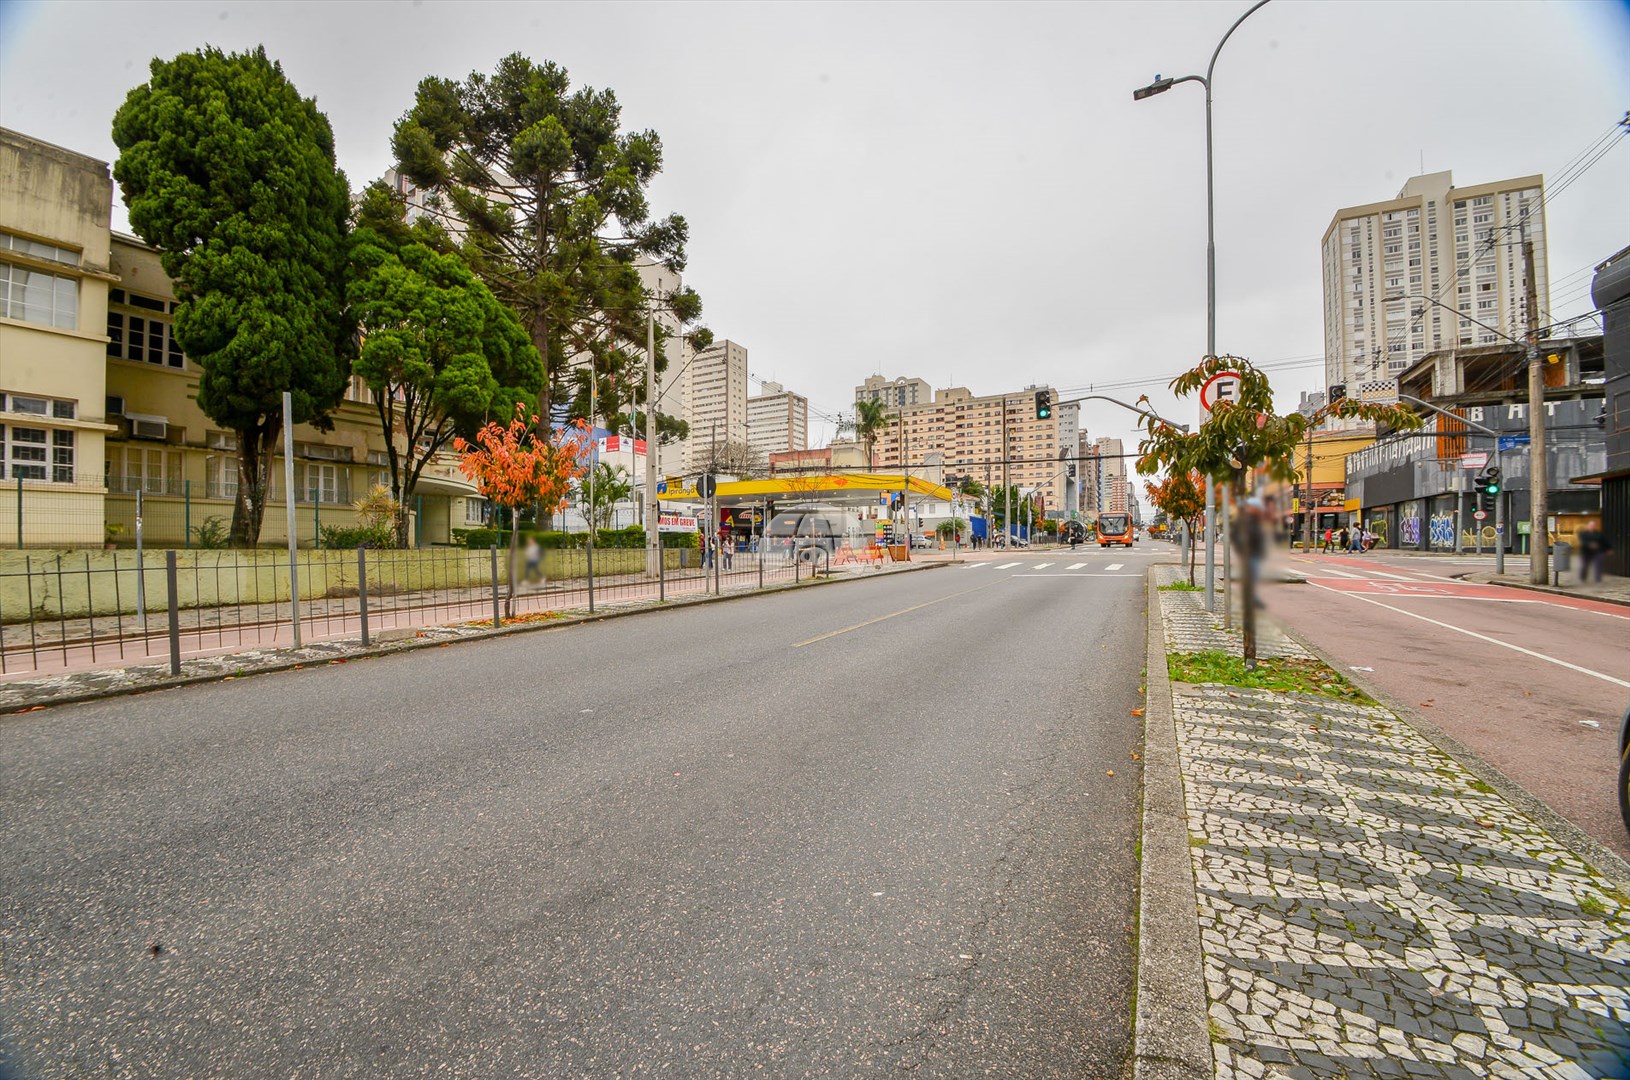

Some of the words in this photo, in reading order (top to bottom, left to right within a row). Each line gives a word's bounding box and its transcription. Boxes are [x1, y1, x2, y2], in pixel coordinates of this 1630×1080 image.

[668, 487, 695, 496] Ipiranga
[671, 517, 679, 526] EM
[680, 518, 696, 526] GREVE
